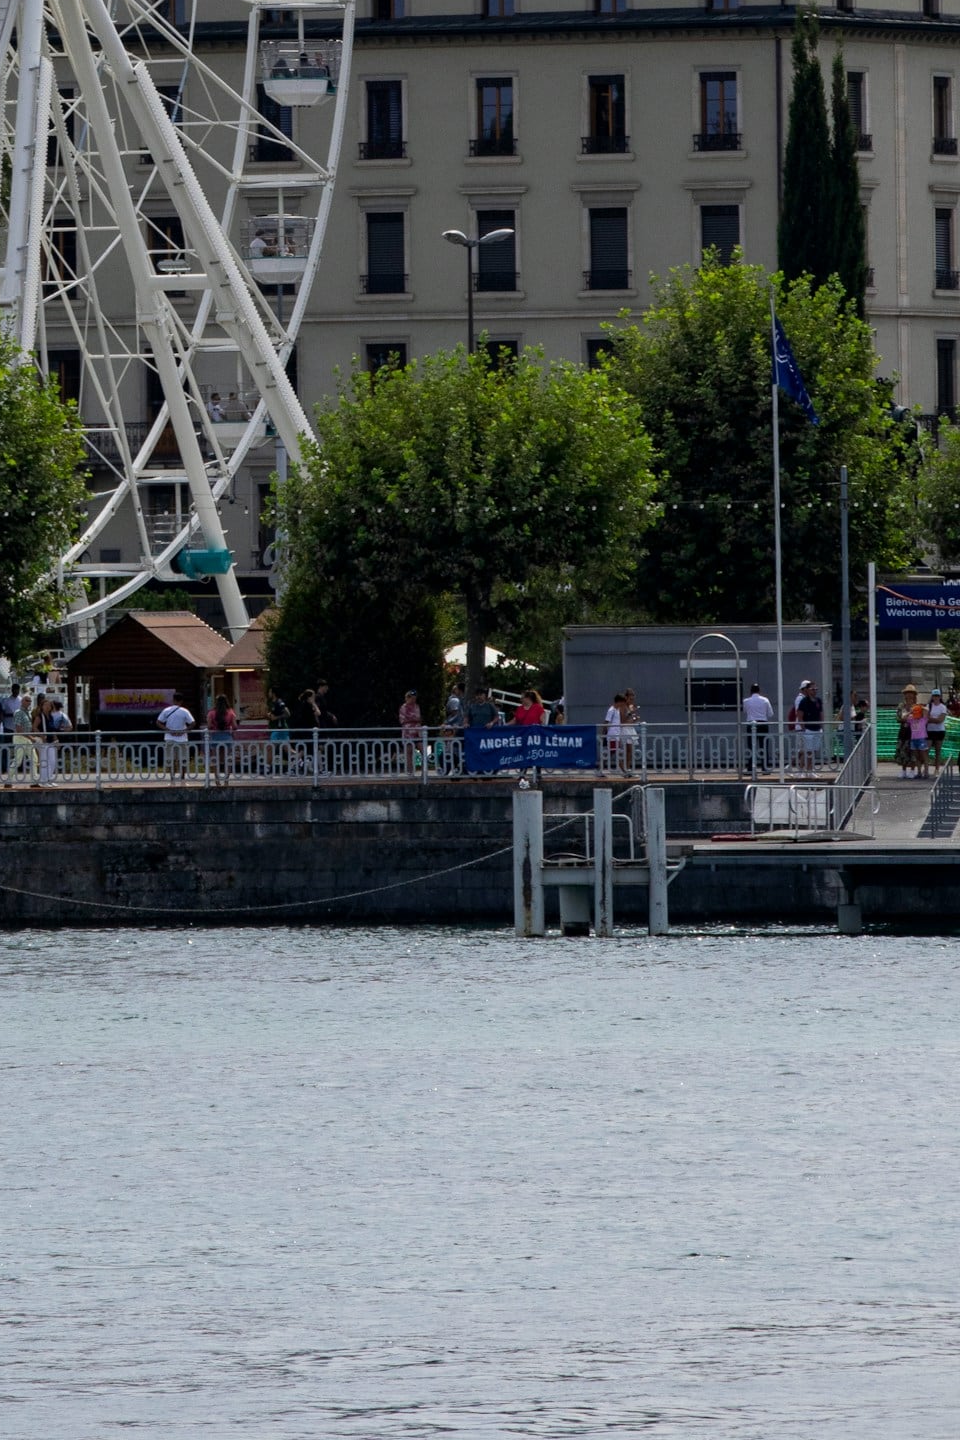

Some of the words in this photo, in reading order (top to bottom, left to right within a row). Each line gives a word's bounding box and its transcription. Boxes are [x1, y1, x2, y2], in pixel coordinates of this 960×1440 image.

[886, 597, 937, 607] Bienvenue
[939, 597, 946, 606] à
[886, 608, 932, 617] Welcome
[935, 609, 946, 617] to
[479, 735, 522, 749] ANCRÉE
[527, 734, 541, 746] AU
[545, 733, 583, 748] LÉMAN
